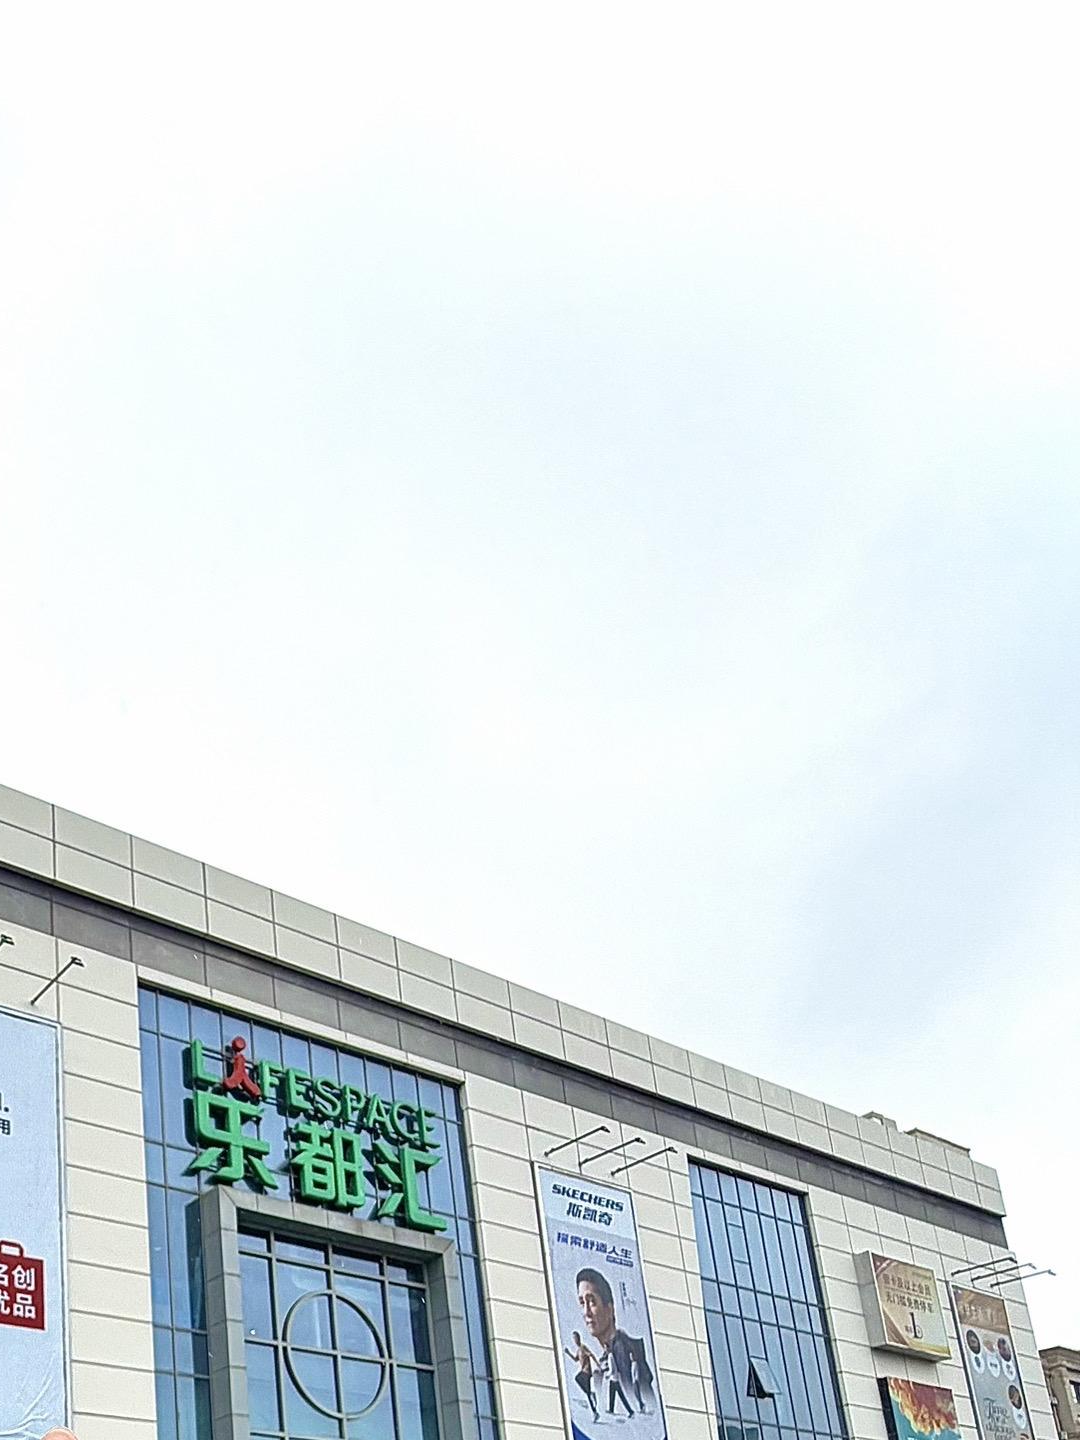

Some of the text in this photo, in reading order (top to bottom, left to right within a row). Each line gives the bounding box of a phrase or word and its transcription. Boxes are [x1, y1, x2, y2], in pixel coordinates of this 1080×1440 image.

[191, 1035, 441, 1150] LIFESPACE
[188, 1090, 448, 1232] 乐都汇
[551, 1183, 624, 1212] SKECHERS
[566, 1201, 613, 1226] 斯凯奇
